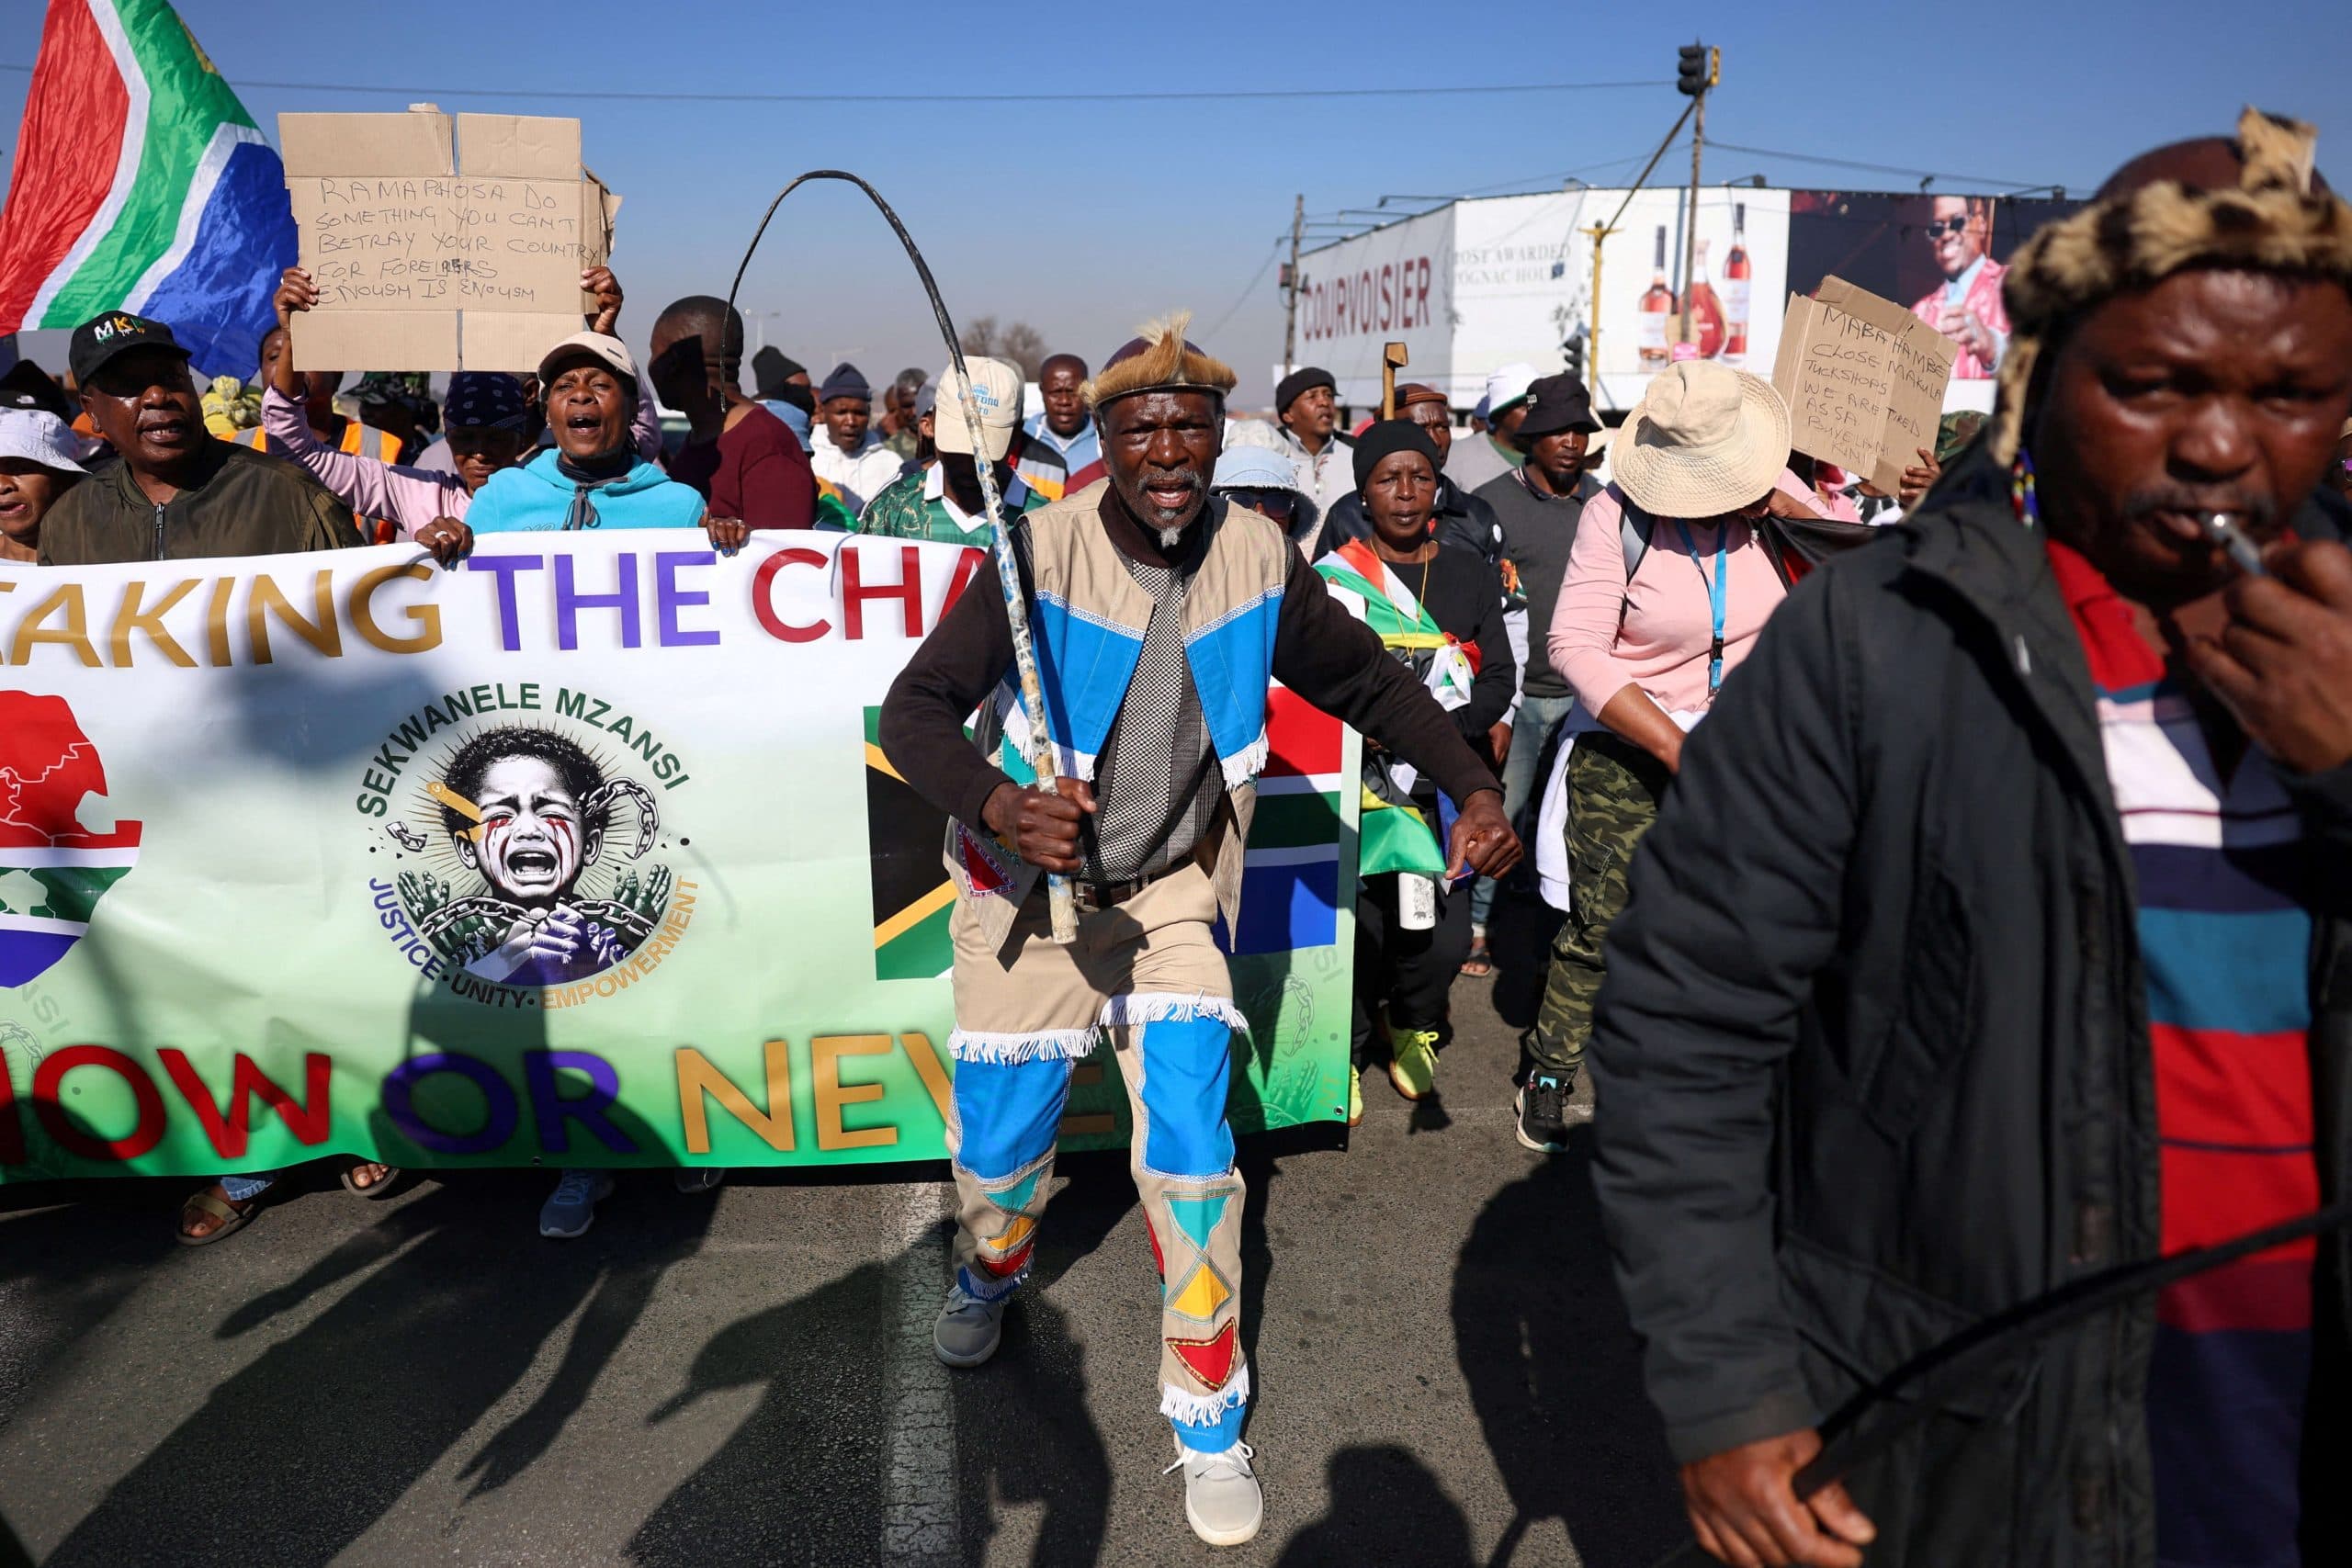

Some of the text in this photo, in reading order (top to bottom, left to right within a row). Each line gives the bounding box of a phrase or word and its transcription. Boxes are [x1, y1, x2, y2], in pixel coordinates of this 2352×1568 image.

[320, 177, 557, 209] RAMAPHOSA DO
[315, 206, 436, 231] SOMETHING
[447, 207, 497, 231] YOU
[318, 231, 598, 267] BETRAY YOUR COUNTRY
[1454, 248, 1487, 265] OST
[315, 261, 366, 284] FOR
[416, 278, 447, 299] IS
[1303, 256, 1430, 342] COURVOISIER
[1811, 344, 1882, 368] CLOSE
[1804, 359, 1888, 396] TUCKSHOPS
[1804, 379, 1920, 438] WE ARE TIRED
[1806, 397, 1828, 416] AS
[467, 550, 721, 651] THE
[356, 682, 690, 818] SEKWANELE MZANSI
[368, 875, 700, 1010] JUSTICE UNITY EMPOWERMENT
[379, 1050, 641, 1154] OR
